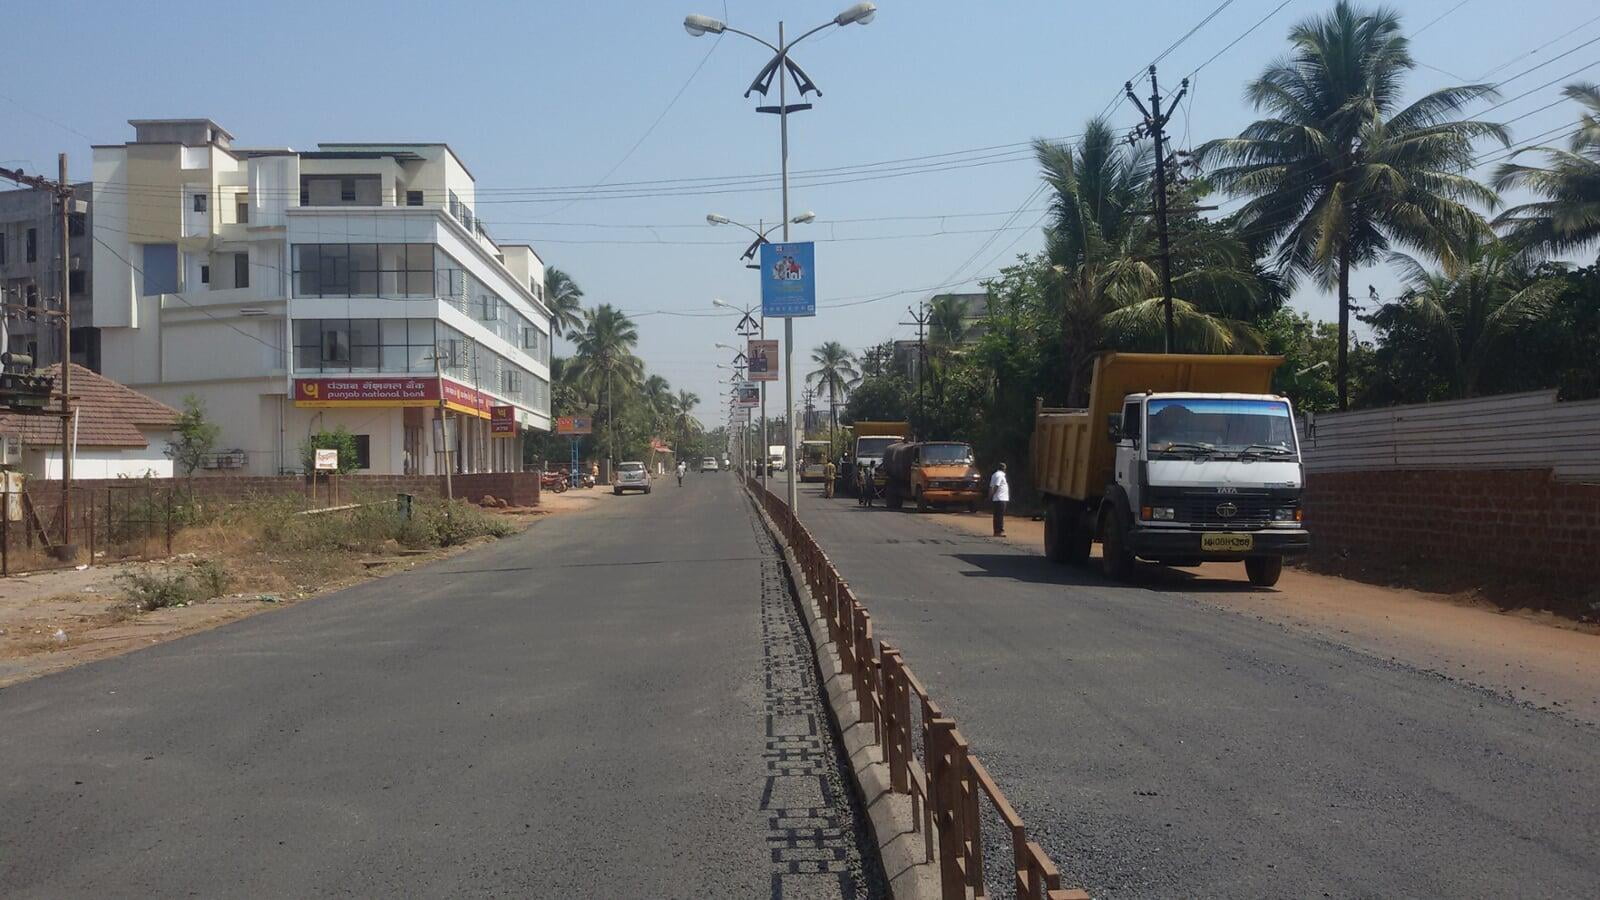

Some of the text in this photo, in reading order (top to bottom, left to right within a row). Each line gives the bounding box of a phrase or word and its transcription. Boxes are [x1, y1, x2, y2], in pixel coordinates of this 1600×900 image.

[327, 389, 425, 399] punjab national bank
